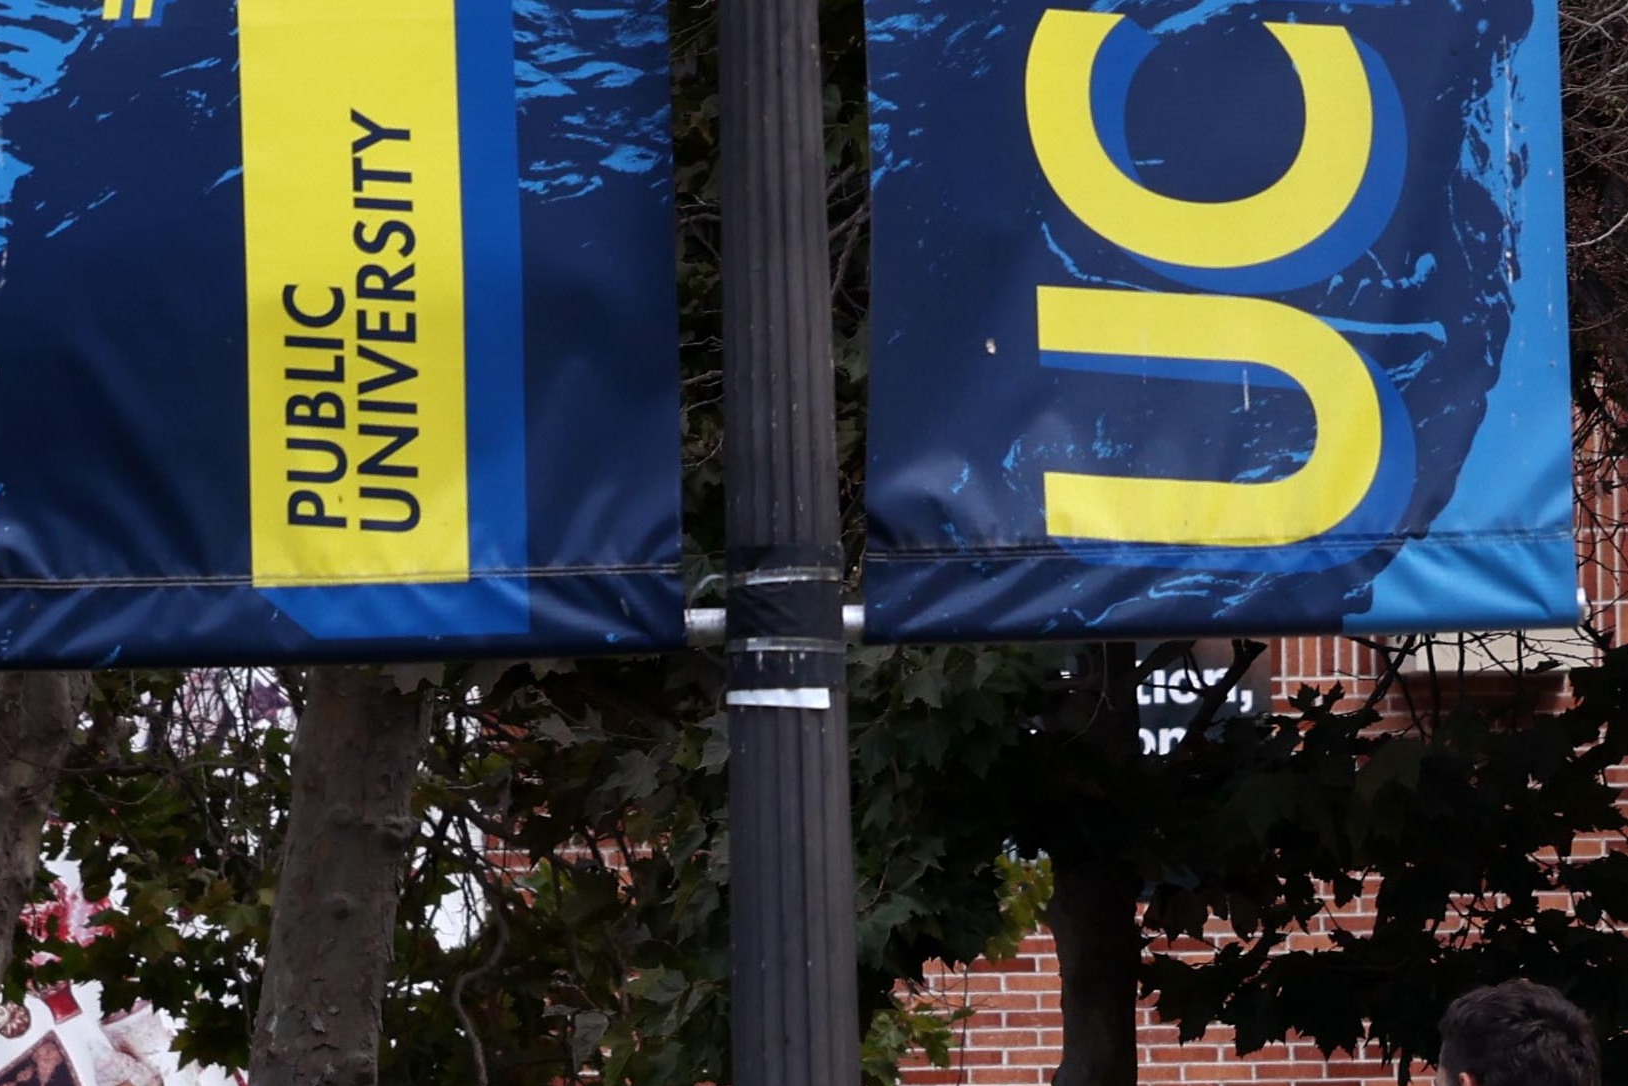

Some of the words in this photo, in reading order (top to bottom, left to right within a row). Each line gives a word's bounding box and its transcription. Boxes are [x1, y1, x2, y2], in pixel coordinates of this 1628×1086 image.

[282, 283, 349, 530] PUBLIC
[350, 108, 421, 534] UNIVERSITY
[1024, 0, 1382, 548] UC
